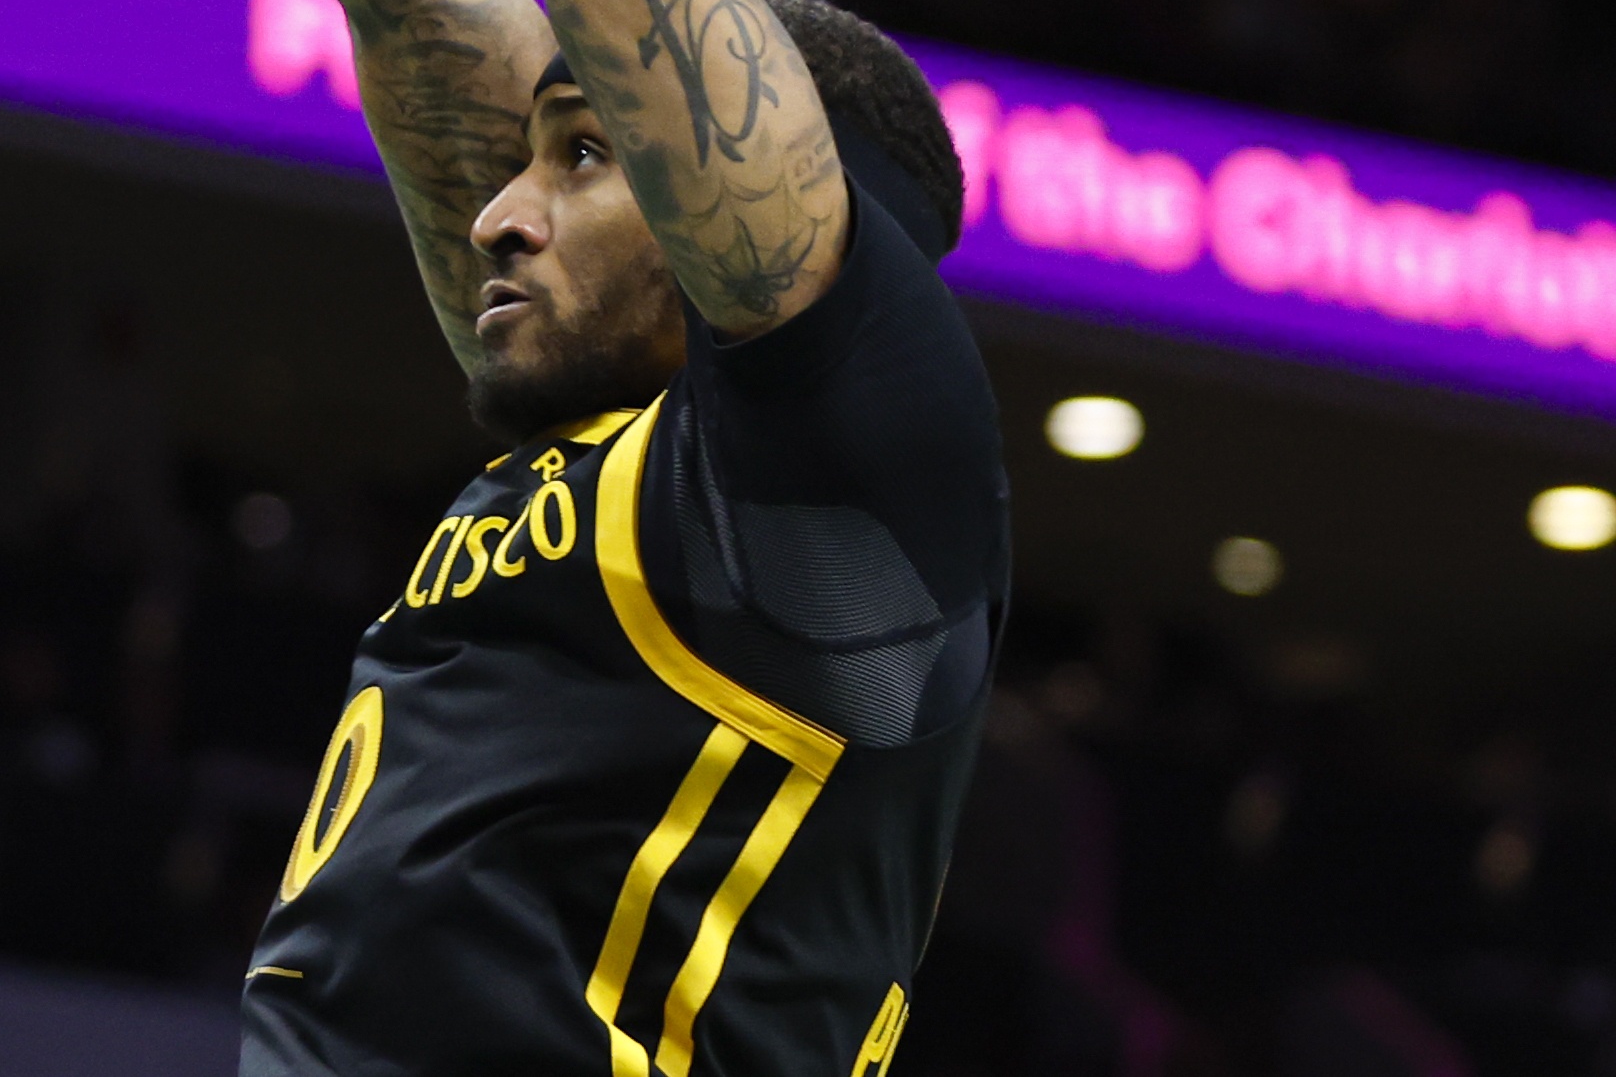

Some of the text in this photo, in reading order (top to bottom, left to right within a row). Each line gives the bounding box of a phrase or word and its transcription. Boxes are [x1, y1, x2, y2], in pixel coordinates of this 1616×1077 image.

[996, 104, 1208, 272] the
[380, 480, 577, 622] CISCO
[280, 686, 383, 904] 0
